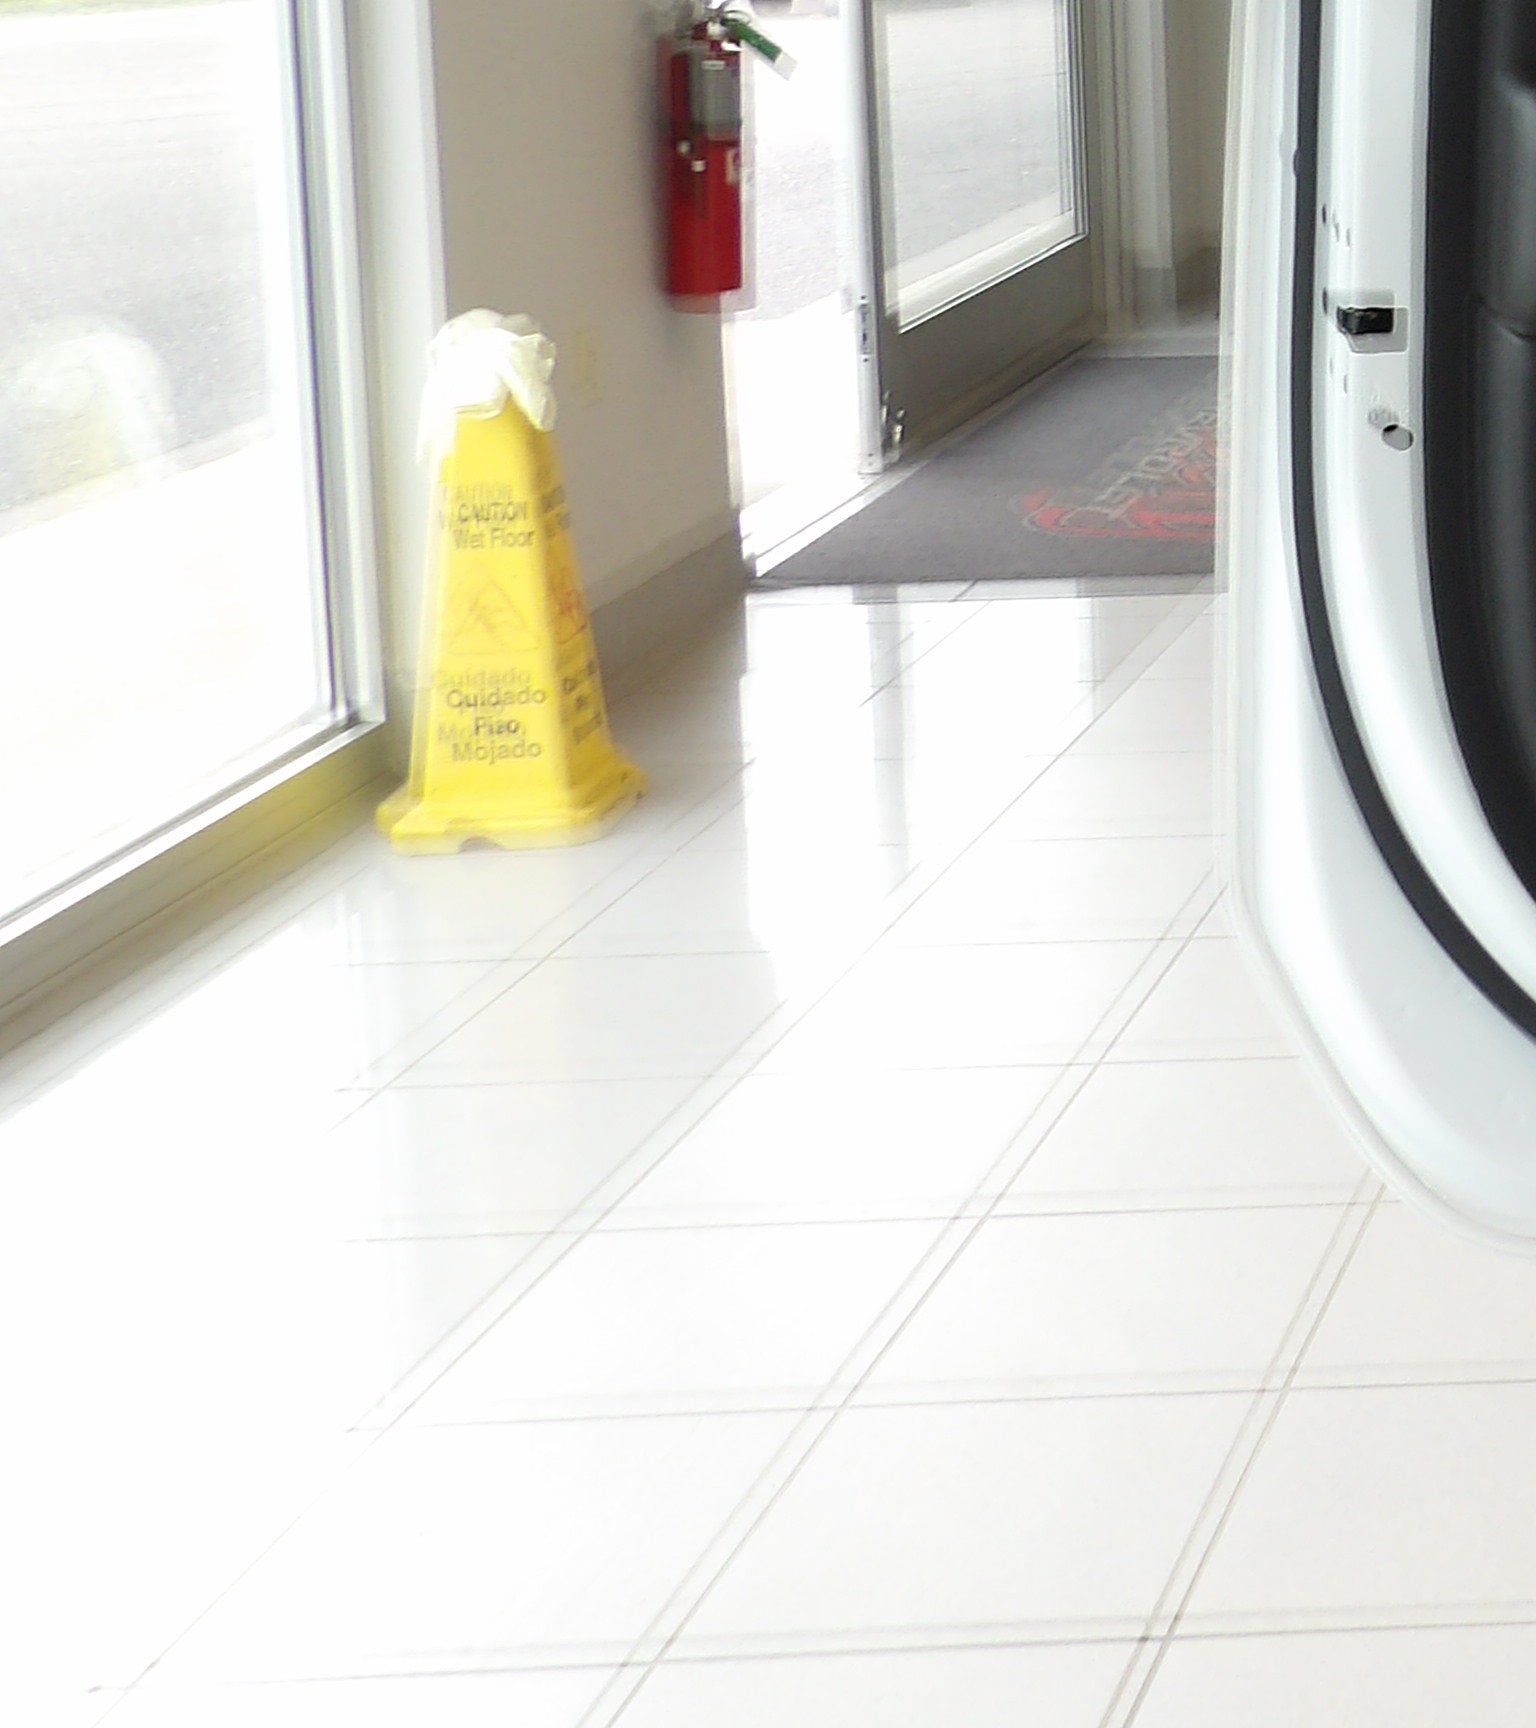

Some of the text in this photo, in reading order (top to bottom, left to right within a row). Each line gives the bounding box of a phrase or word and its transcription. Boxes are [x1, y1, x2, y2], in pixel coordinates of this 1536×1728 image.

[457, 500, 529, 523] CAUTION
[453, 526, 536, 550] Wet Floor
[447, 685, 547, 708] Cuidado
[451, 739, 543, 765] Mojado
